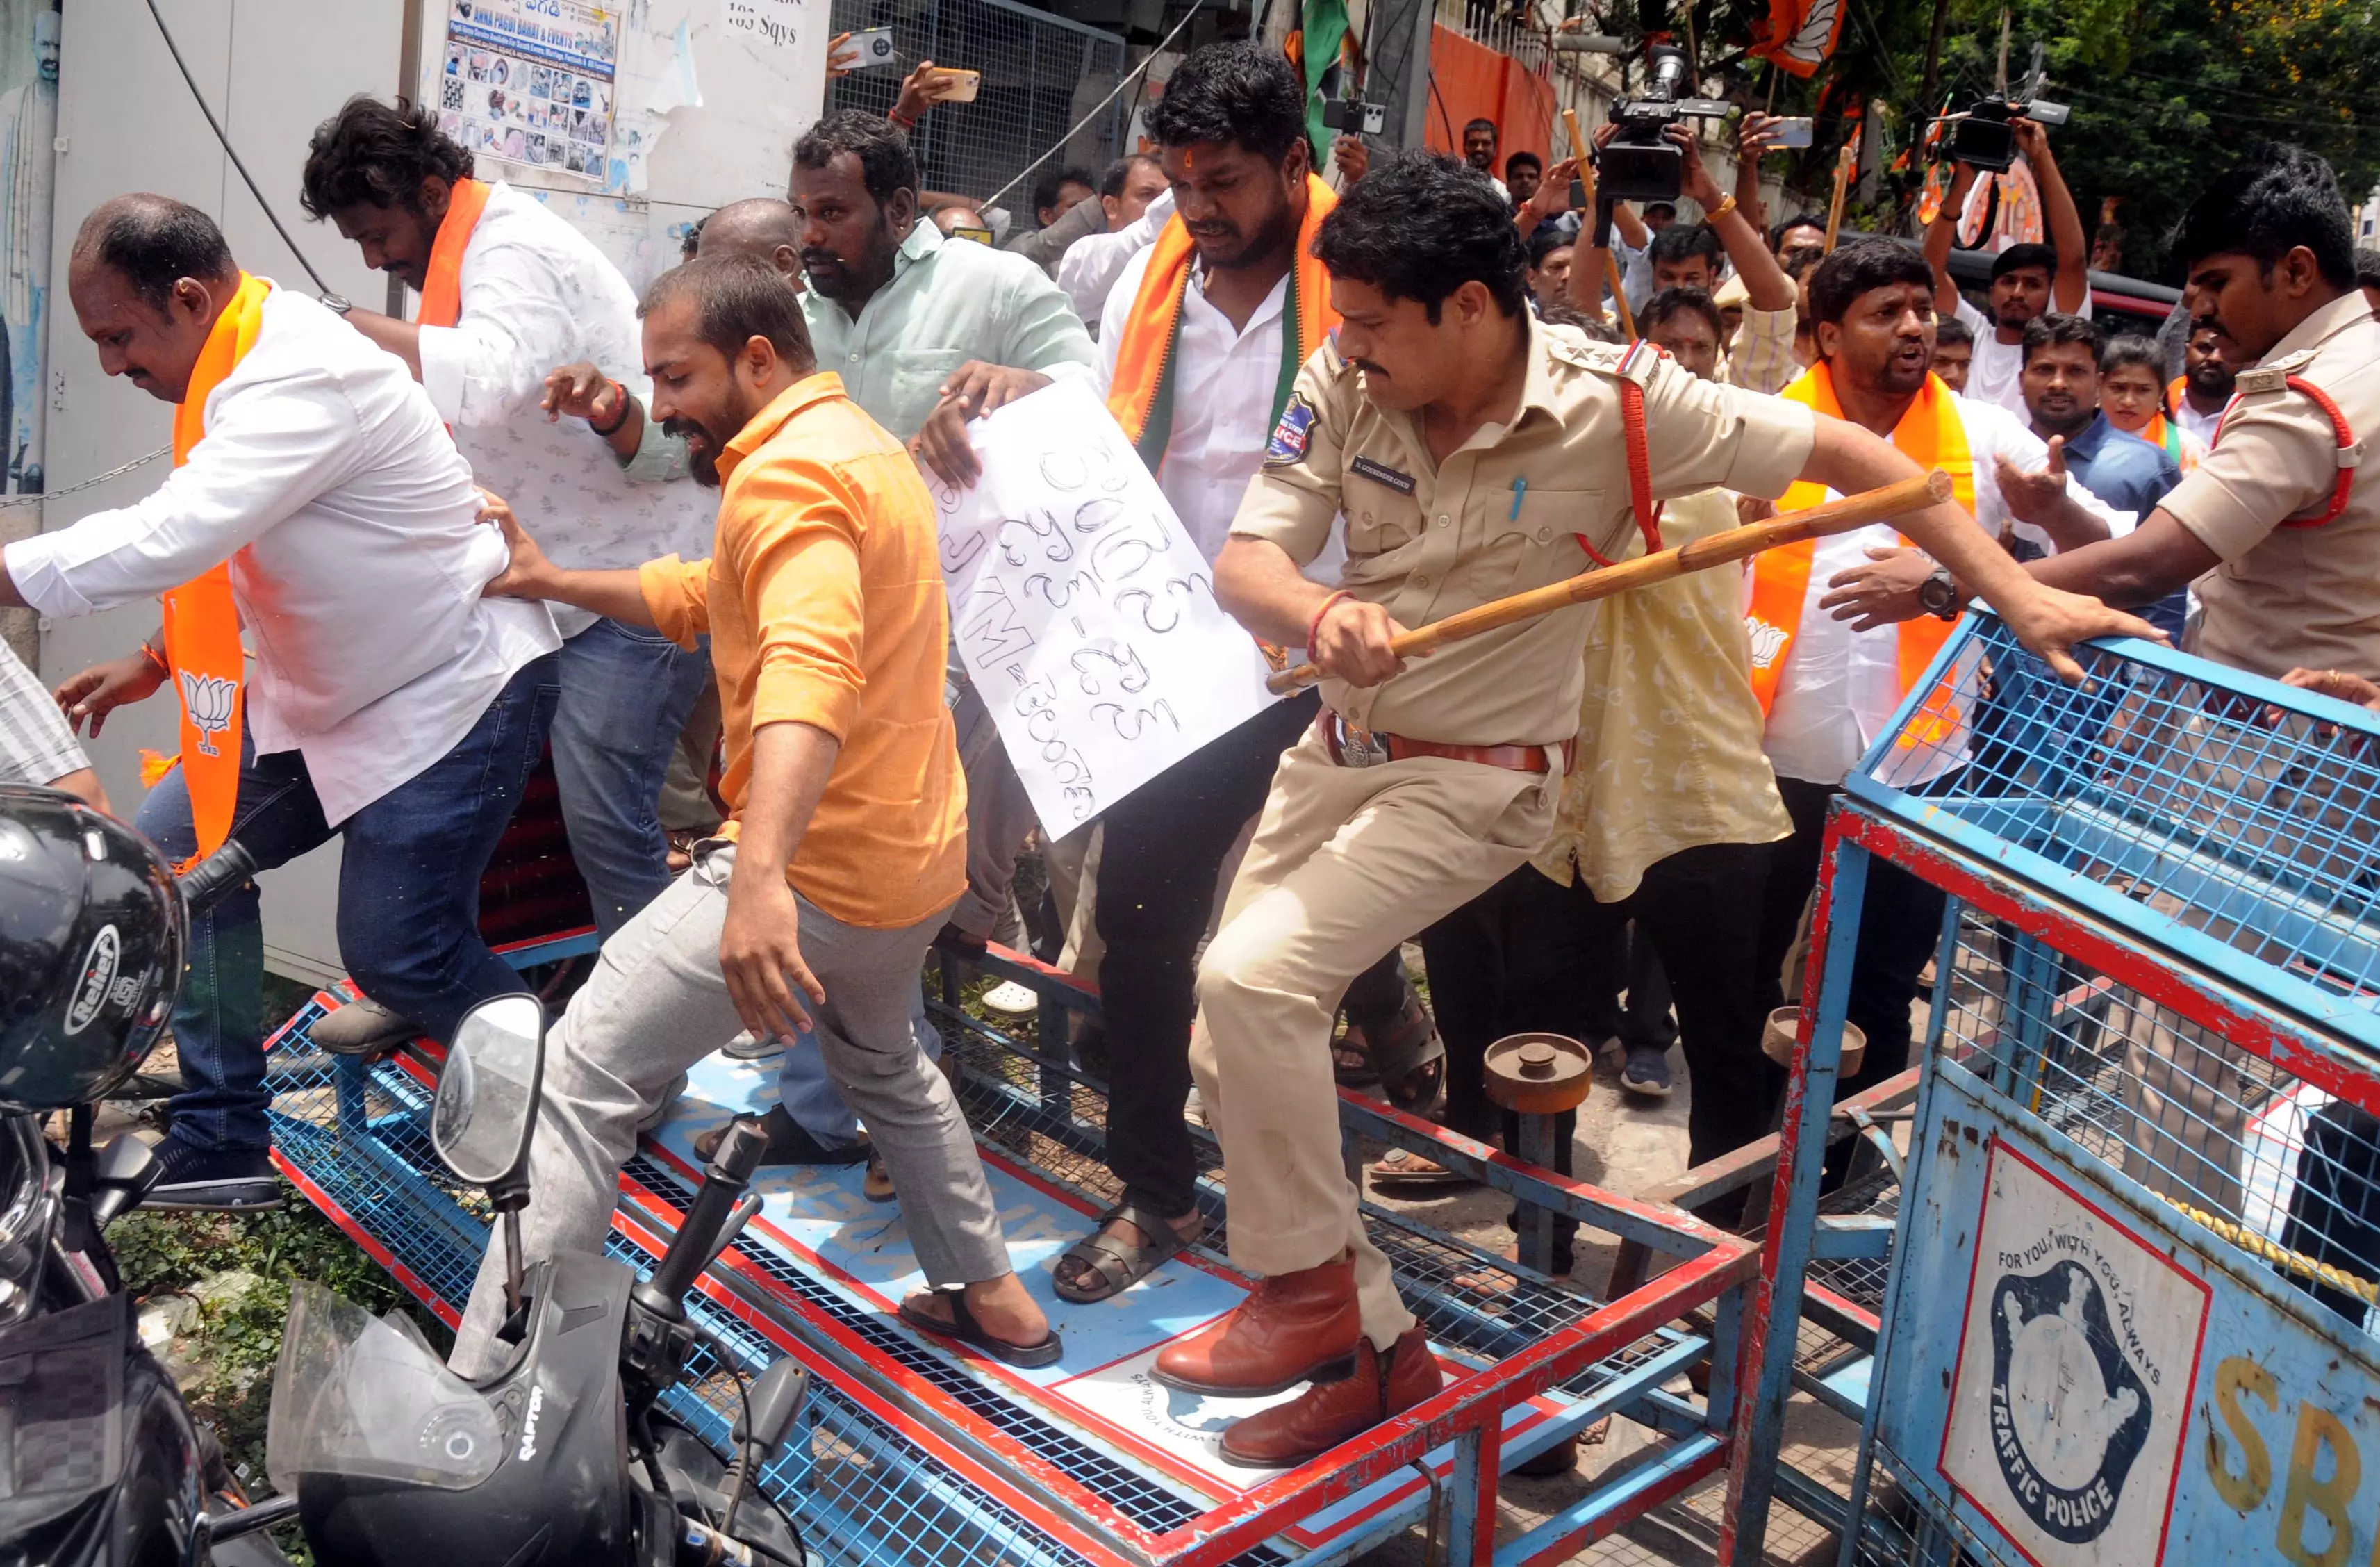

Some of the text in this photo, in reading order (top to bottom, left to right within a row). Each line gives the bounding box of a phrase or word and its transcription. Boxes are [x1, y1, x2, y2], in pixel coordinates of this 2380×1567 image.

[547, 27, 573, 49] EVENTS
[72, 935, 114, 1022] Relief
[1999, 1251, 2022, 1269] FOR
[2056, 1234, 2090, 1256] WITH
[2118, 1302, 2162, 1386] ALWAYS
[518, 1385, 544, 1461] RAPTOR
[1992, 1383, 2115, 1528] TRAFFIC POLICE
[2205, 1356, 2380, 1567] SB
